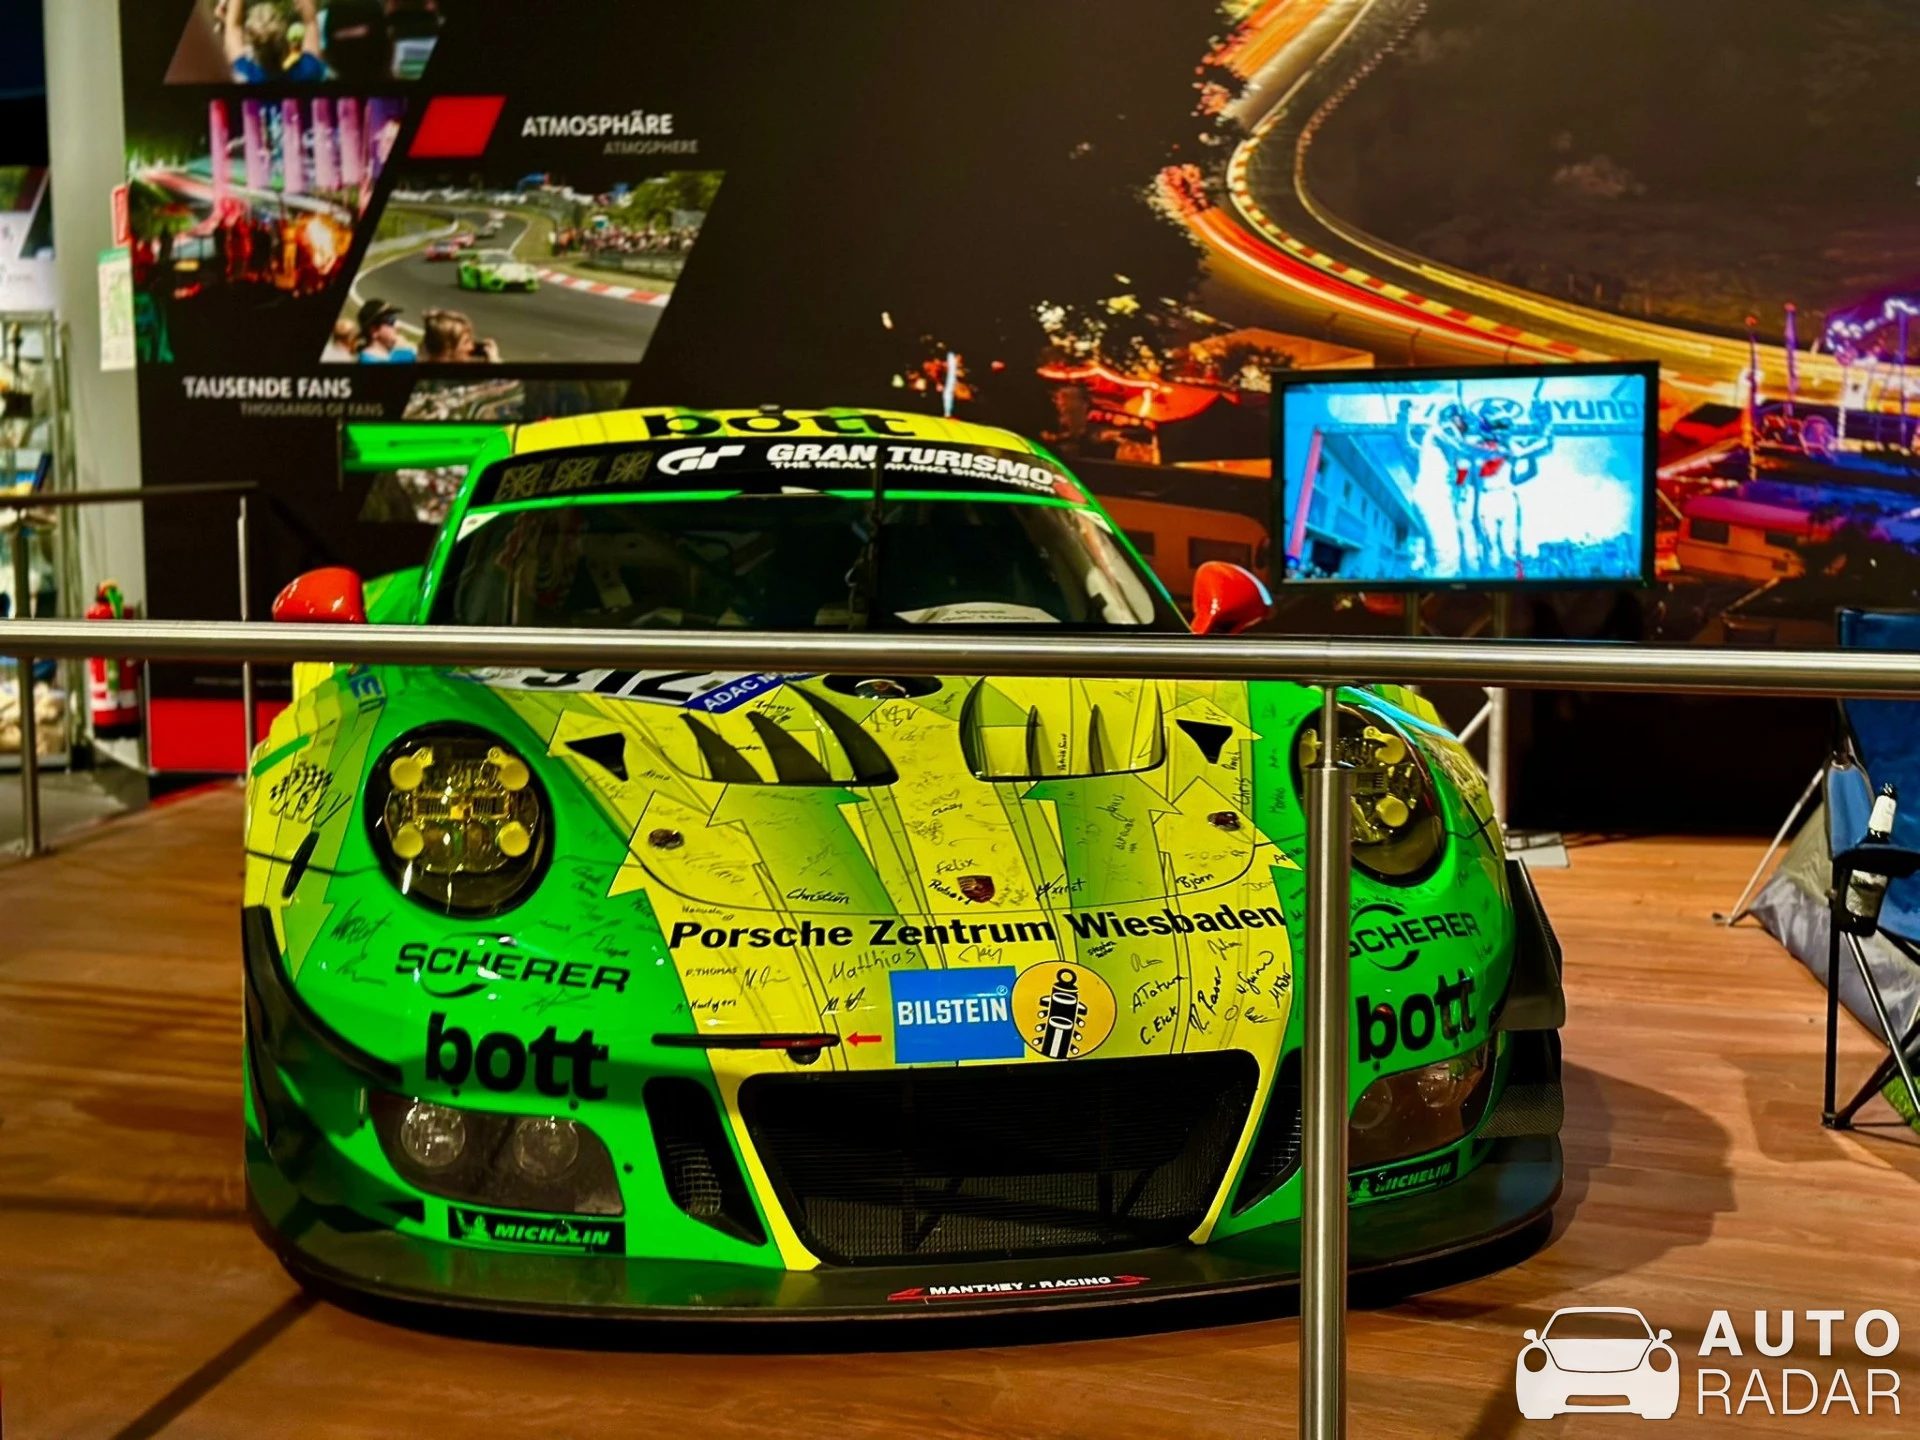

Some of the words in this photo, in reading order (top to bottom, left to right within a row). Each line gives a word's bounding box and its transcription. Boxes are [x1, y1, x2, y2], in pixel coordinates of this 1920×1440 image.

[521, 109, 674, 137] ATMOSPHÄRE
[602, 139, 698, 155] ATMOSPHERE
[182, 376, 293, 399] TAUSENDE
[297, 377, 352, 399] FANS
[643, 413, 917, 438] bott
[766, 444, 878, 463] GRAN
[886, 445, 1054, 485] TURISMO
[771, 461, 812, 469] THE
[815, 461, 867, 469] REAL
[951, 467, 1056, 494] SIMULATOR
[703, 680, 759, 711] ADAC
[668, 920, 853, 949] Porsche
[869, 917, 1057, 946] Zentrum
[1064, 904, 1286, 938] Wiesbaden
[396, 943, 631, 992] SCHERER
[897, 998, 1008, 1025] BILSTEIN
[1355, 967, 1476, 1063] bott
[425, 1011, 609, 1100] bott
[929, 1281, 1023, 1296] MANTHEY
[1039, 1276, 1112, 1289] RACING
